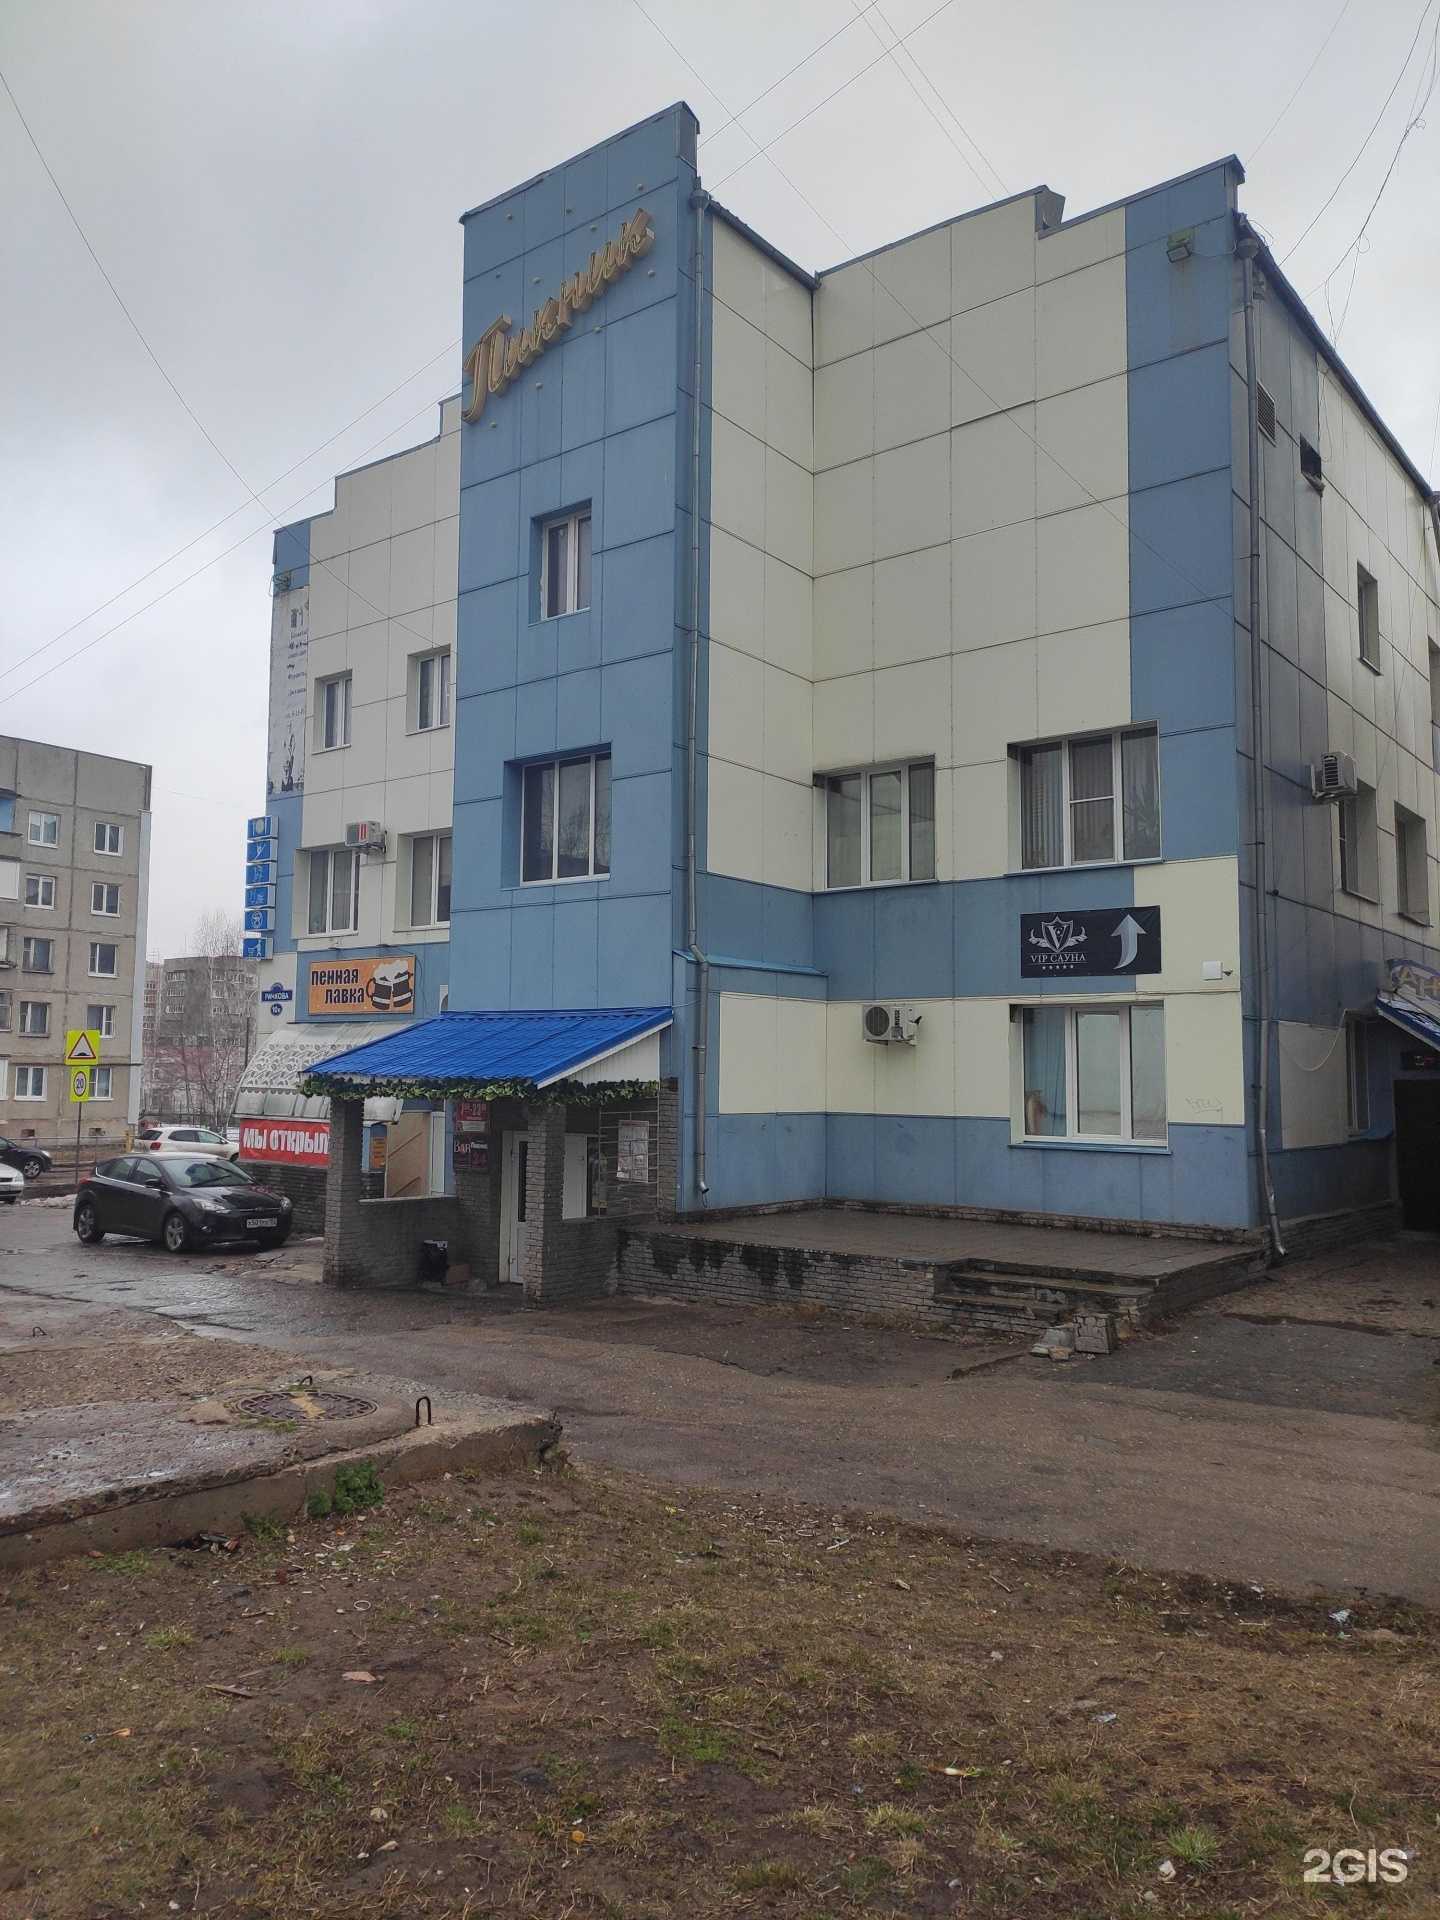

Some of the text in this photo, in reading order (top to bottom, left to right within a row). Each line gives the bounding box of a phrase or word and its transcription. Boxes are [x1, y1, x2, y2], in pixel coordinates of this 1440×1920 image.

[462, 208, 655, 424] Пикник
[1030, 953, 1086, 963] VIP САУНА
[76, 1078, 84, 1089] 20
